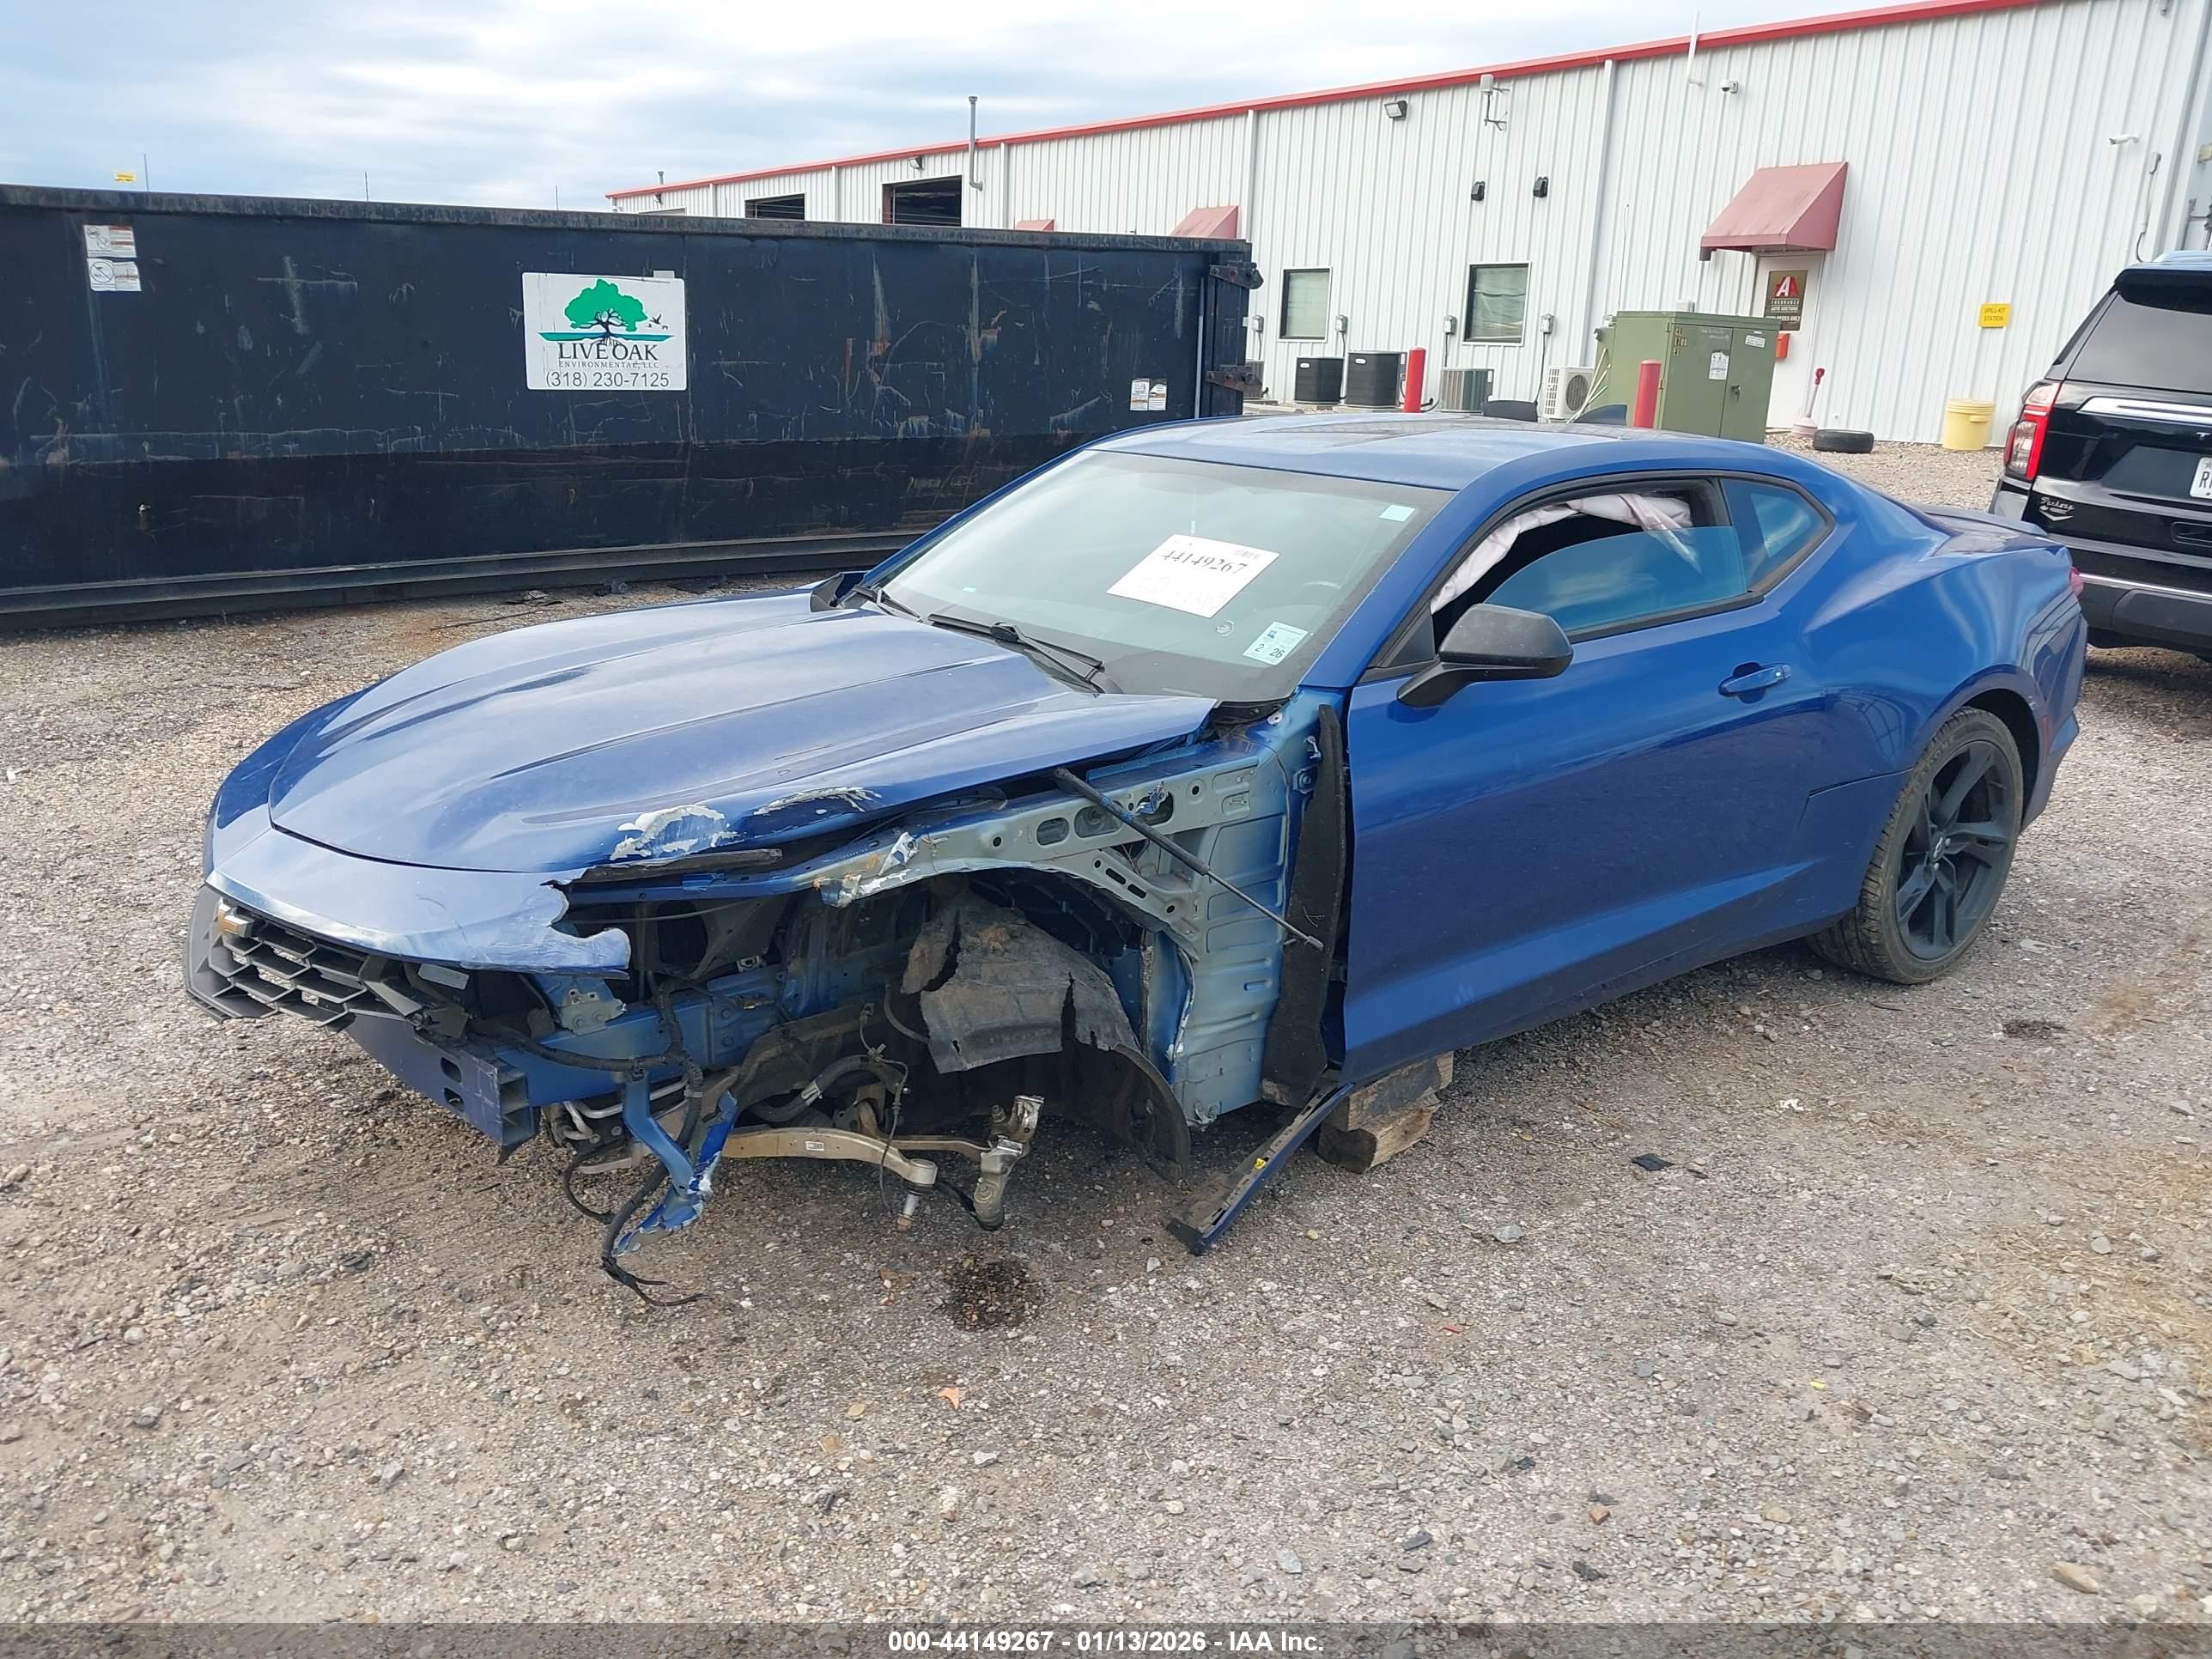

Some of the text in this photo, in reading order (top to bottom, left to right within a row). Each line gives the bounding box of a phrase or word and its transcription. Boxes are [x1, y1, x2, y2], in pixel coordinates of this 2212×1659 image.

[558, 343, 659, 361] LIVE OAK
[545, 372, 670, 388] (318) 230-7125
[1161, 550, 1249, 574] 44149267
[1255, 643, 1285, 659] 2 26
